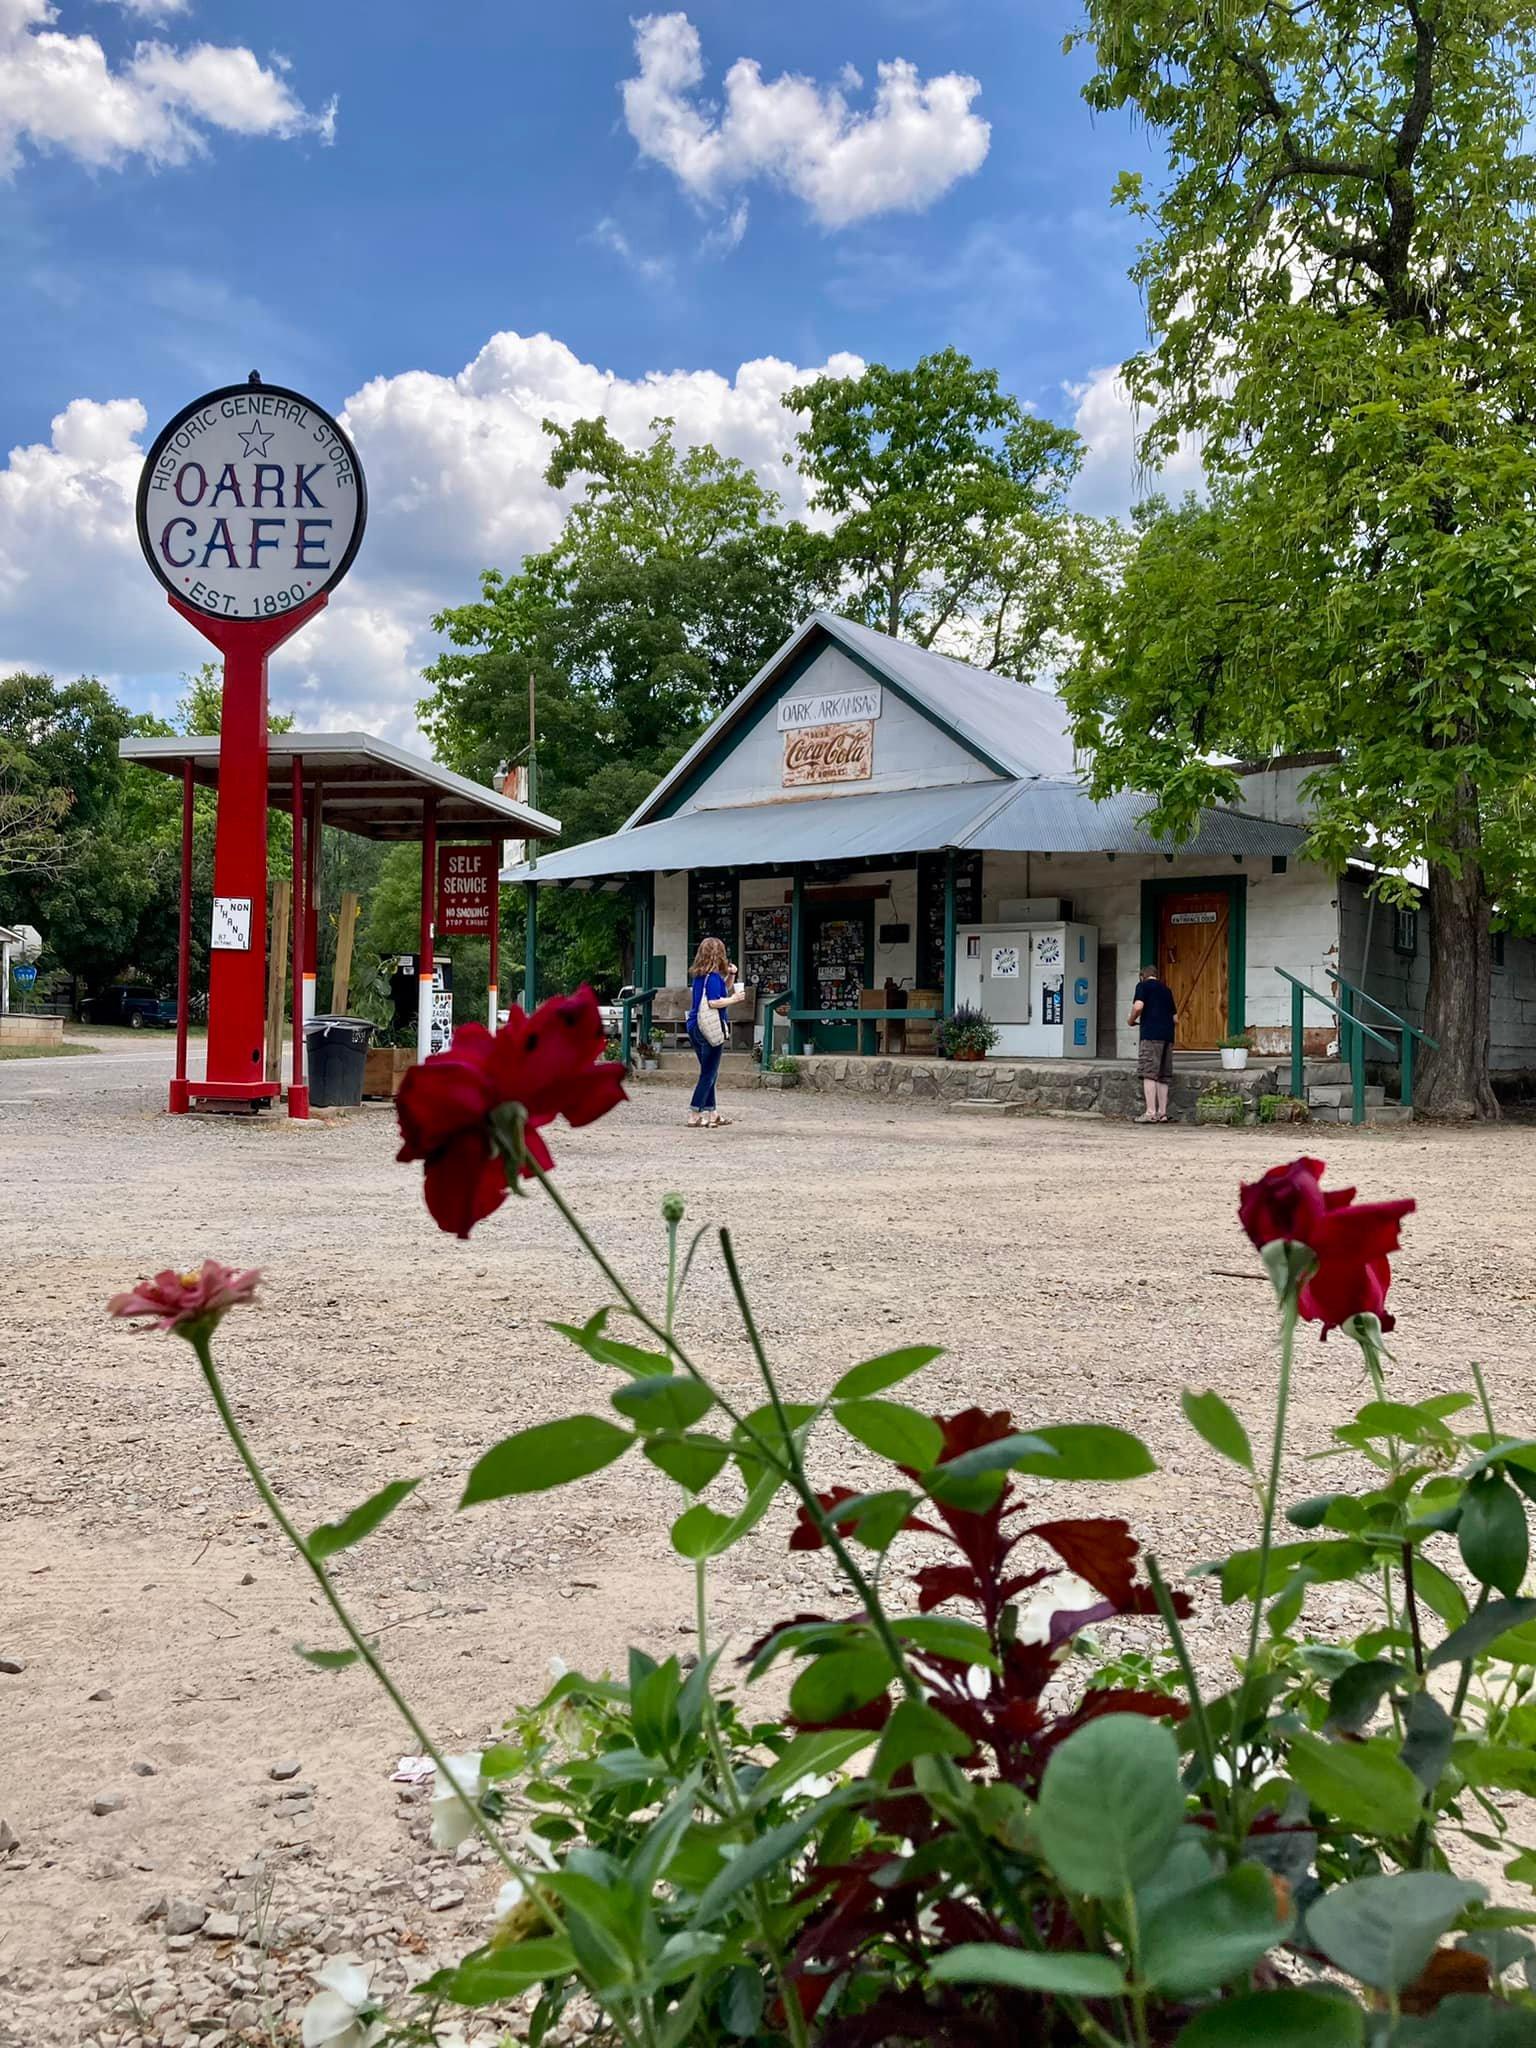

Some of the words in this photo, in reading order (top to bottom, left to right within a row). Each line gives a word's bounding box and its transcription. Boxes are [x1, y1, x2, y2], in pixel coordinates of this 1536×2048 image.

[152, 409, 217, 491] HISTORIC
[220, 397, 308, 429] GENERAL
[313, 424, 354, 488] STORE
[174, 462, 328, 508] OARK
[160, 517, 333, 569] CAFE
[188, 581, 239, 615] EST.
[253, 583, 305, 615] 1890
[818, 694, 877, 718] ARKANSAS
[448, 856, 482, 873] SELF
[443, 877, 488, 894] SERVICE
[214, 899, 246, 948] ETHANOL
[445, 907, 456, 918] NO
[456, 905, 489, 918] SMOKING
[1073, 935, 1089, 1045] ICE
